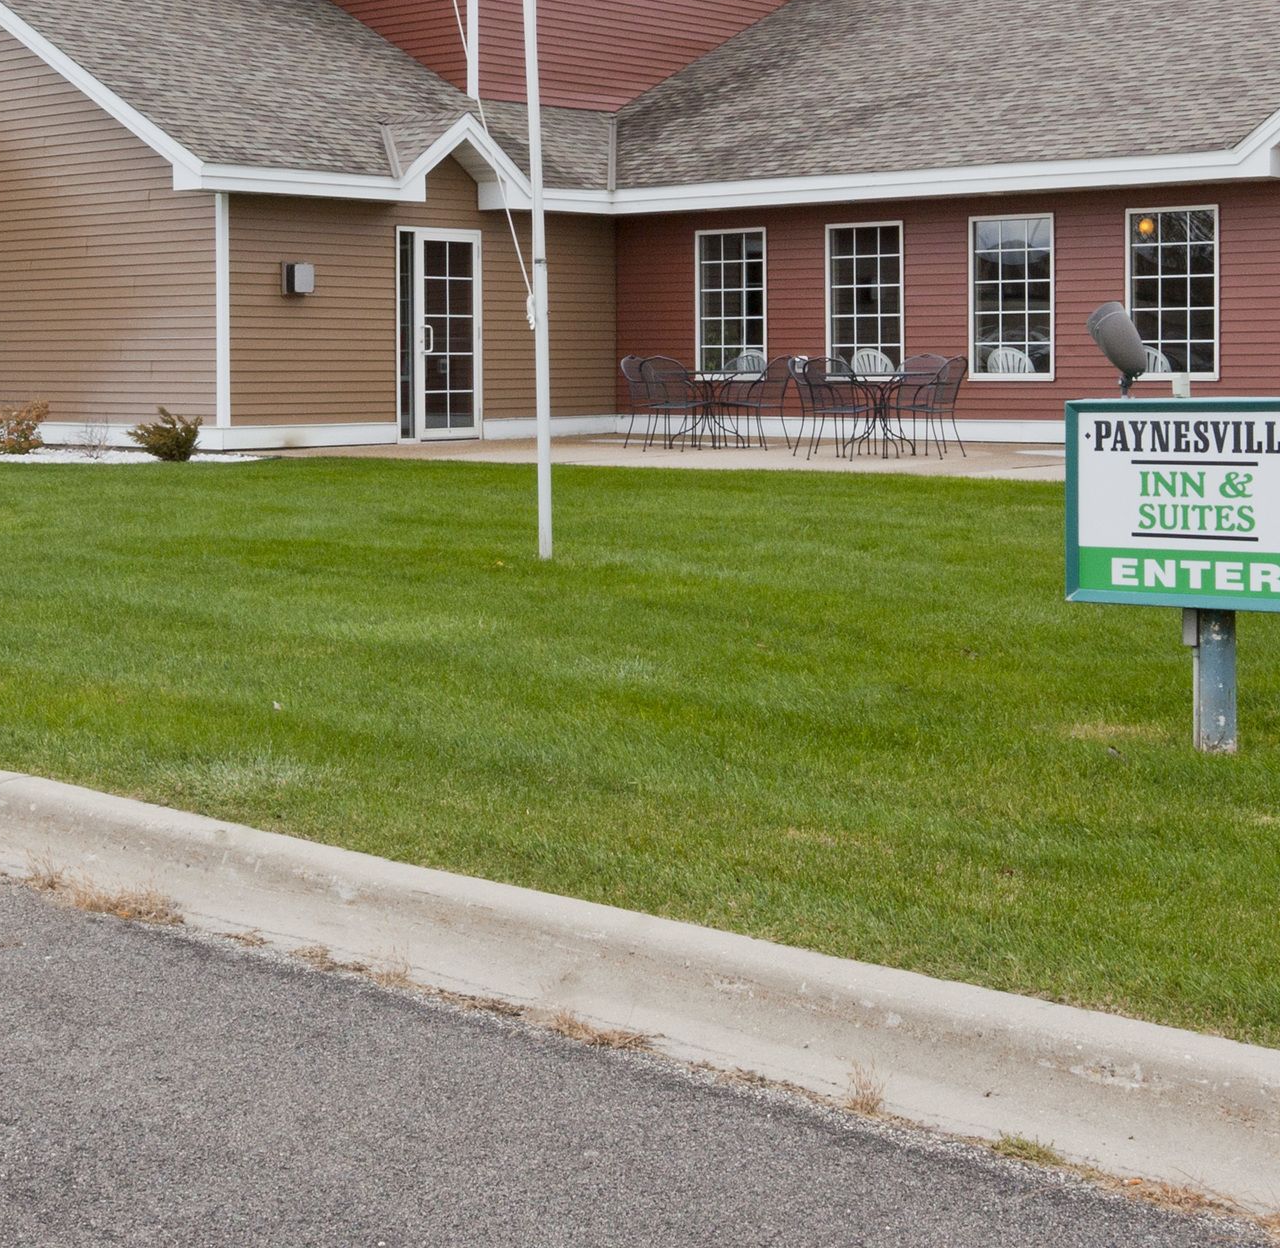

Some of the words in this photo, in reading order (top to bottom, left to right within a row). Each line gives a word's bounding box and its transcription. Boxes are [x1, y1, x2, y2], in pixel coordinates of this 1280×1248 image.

[1139, 471, 1206, 498] INN
[1219, 471, 1254, 498] &
[1137, 504, 1256, 532] SUITES
